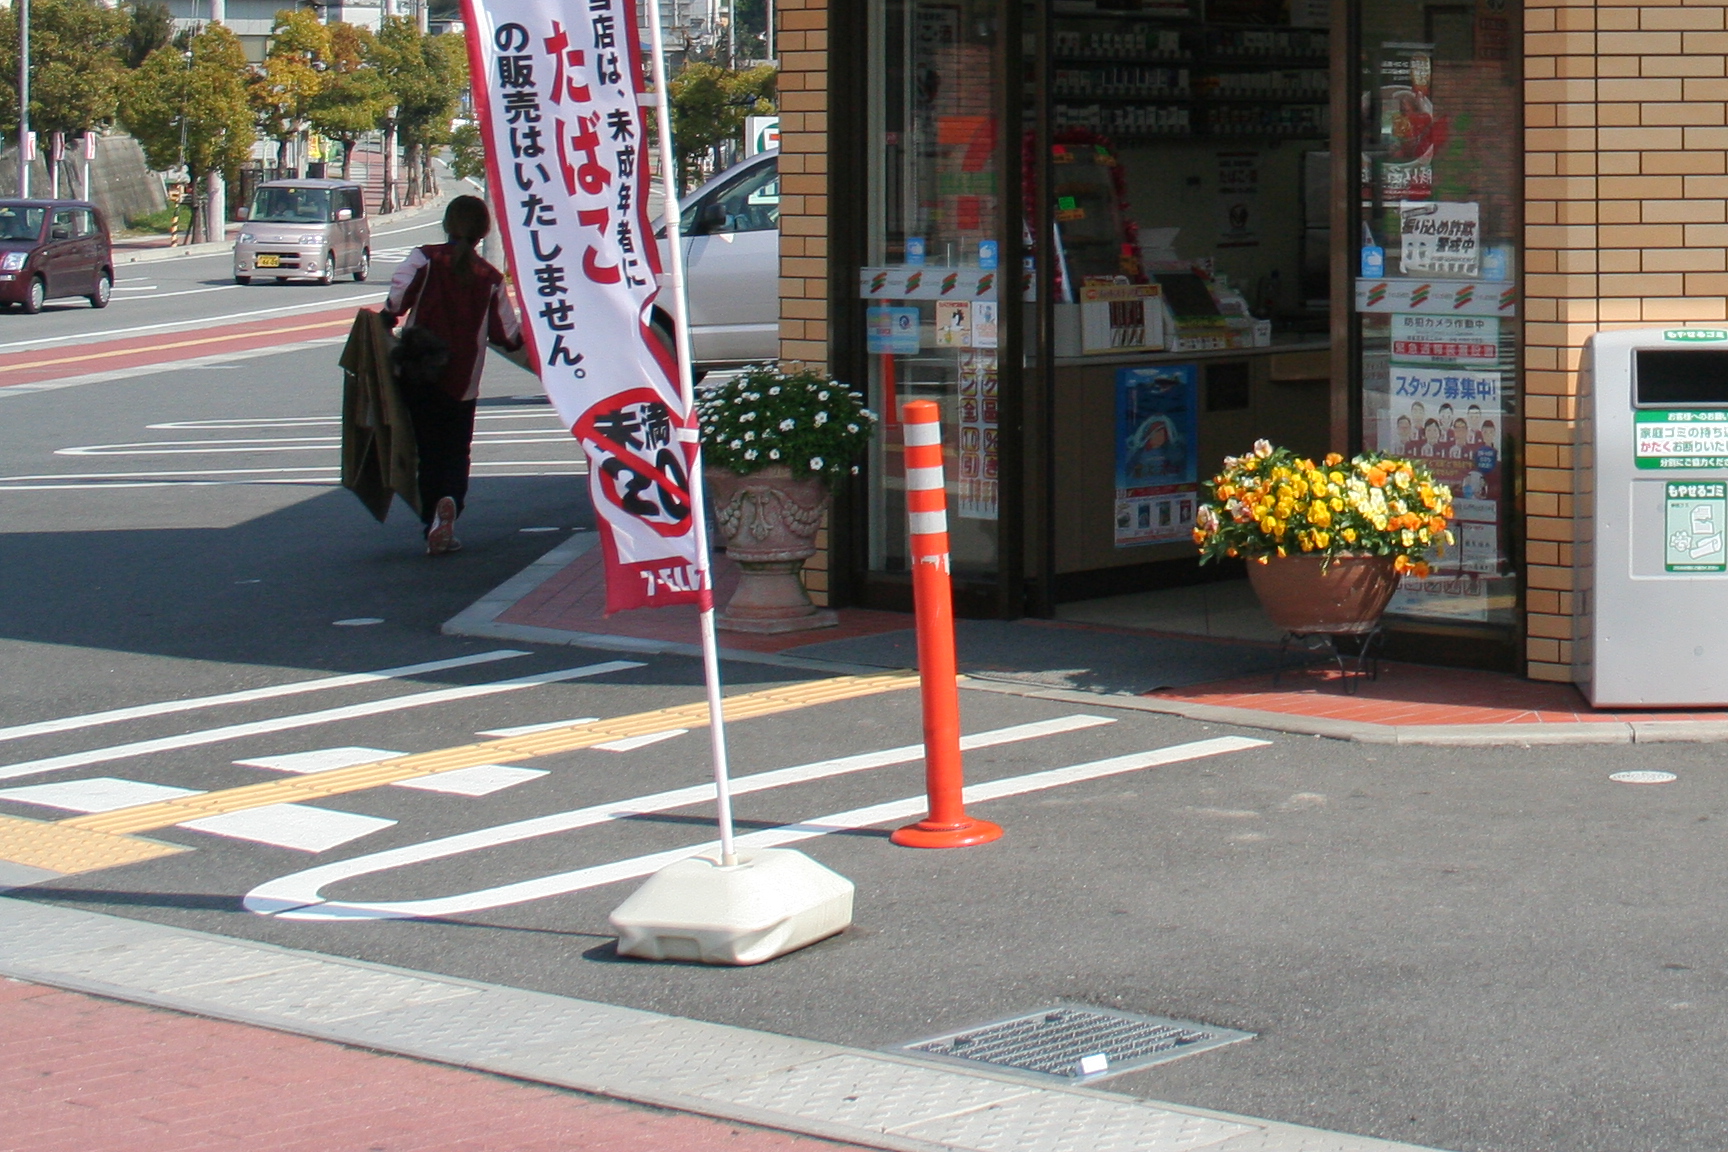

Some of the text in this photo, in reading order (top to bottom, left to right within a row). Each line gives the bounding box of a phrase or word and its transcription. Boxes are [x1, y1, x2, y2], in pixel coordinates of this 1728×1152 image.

[543, 20, 621, 284] たばこ
[494, 22, 587, 380] の販売はいたしません。
[1404, 317, 1485, 328] 防犯カメラ作動中
[1395, 376, 1497, 401] スタッフ募集中!
[1668, 484, 1725, 498] もやせるゴミ
